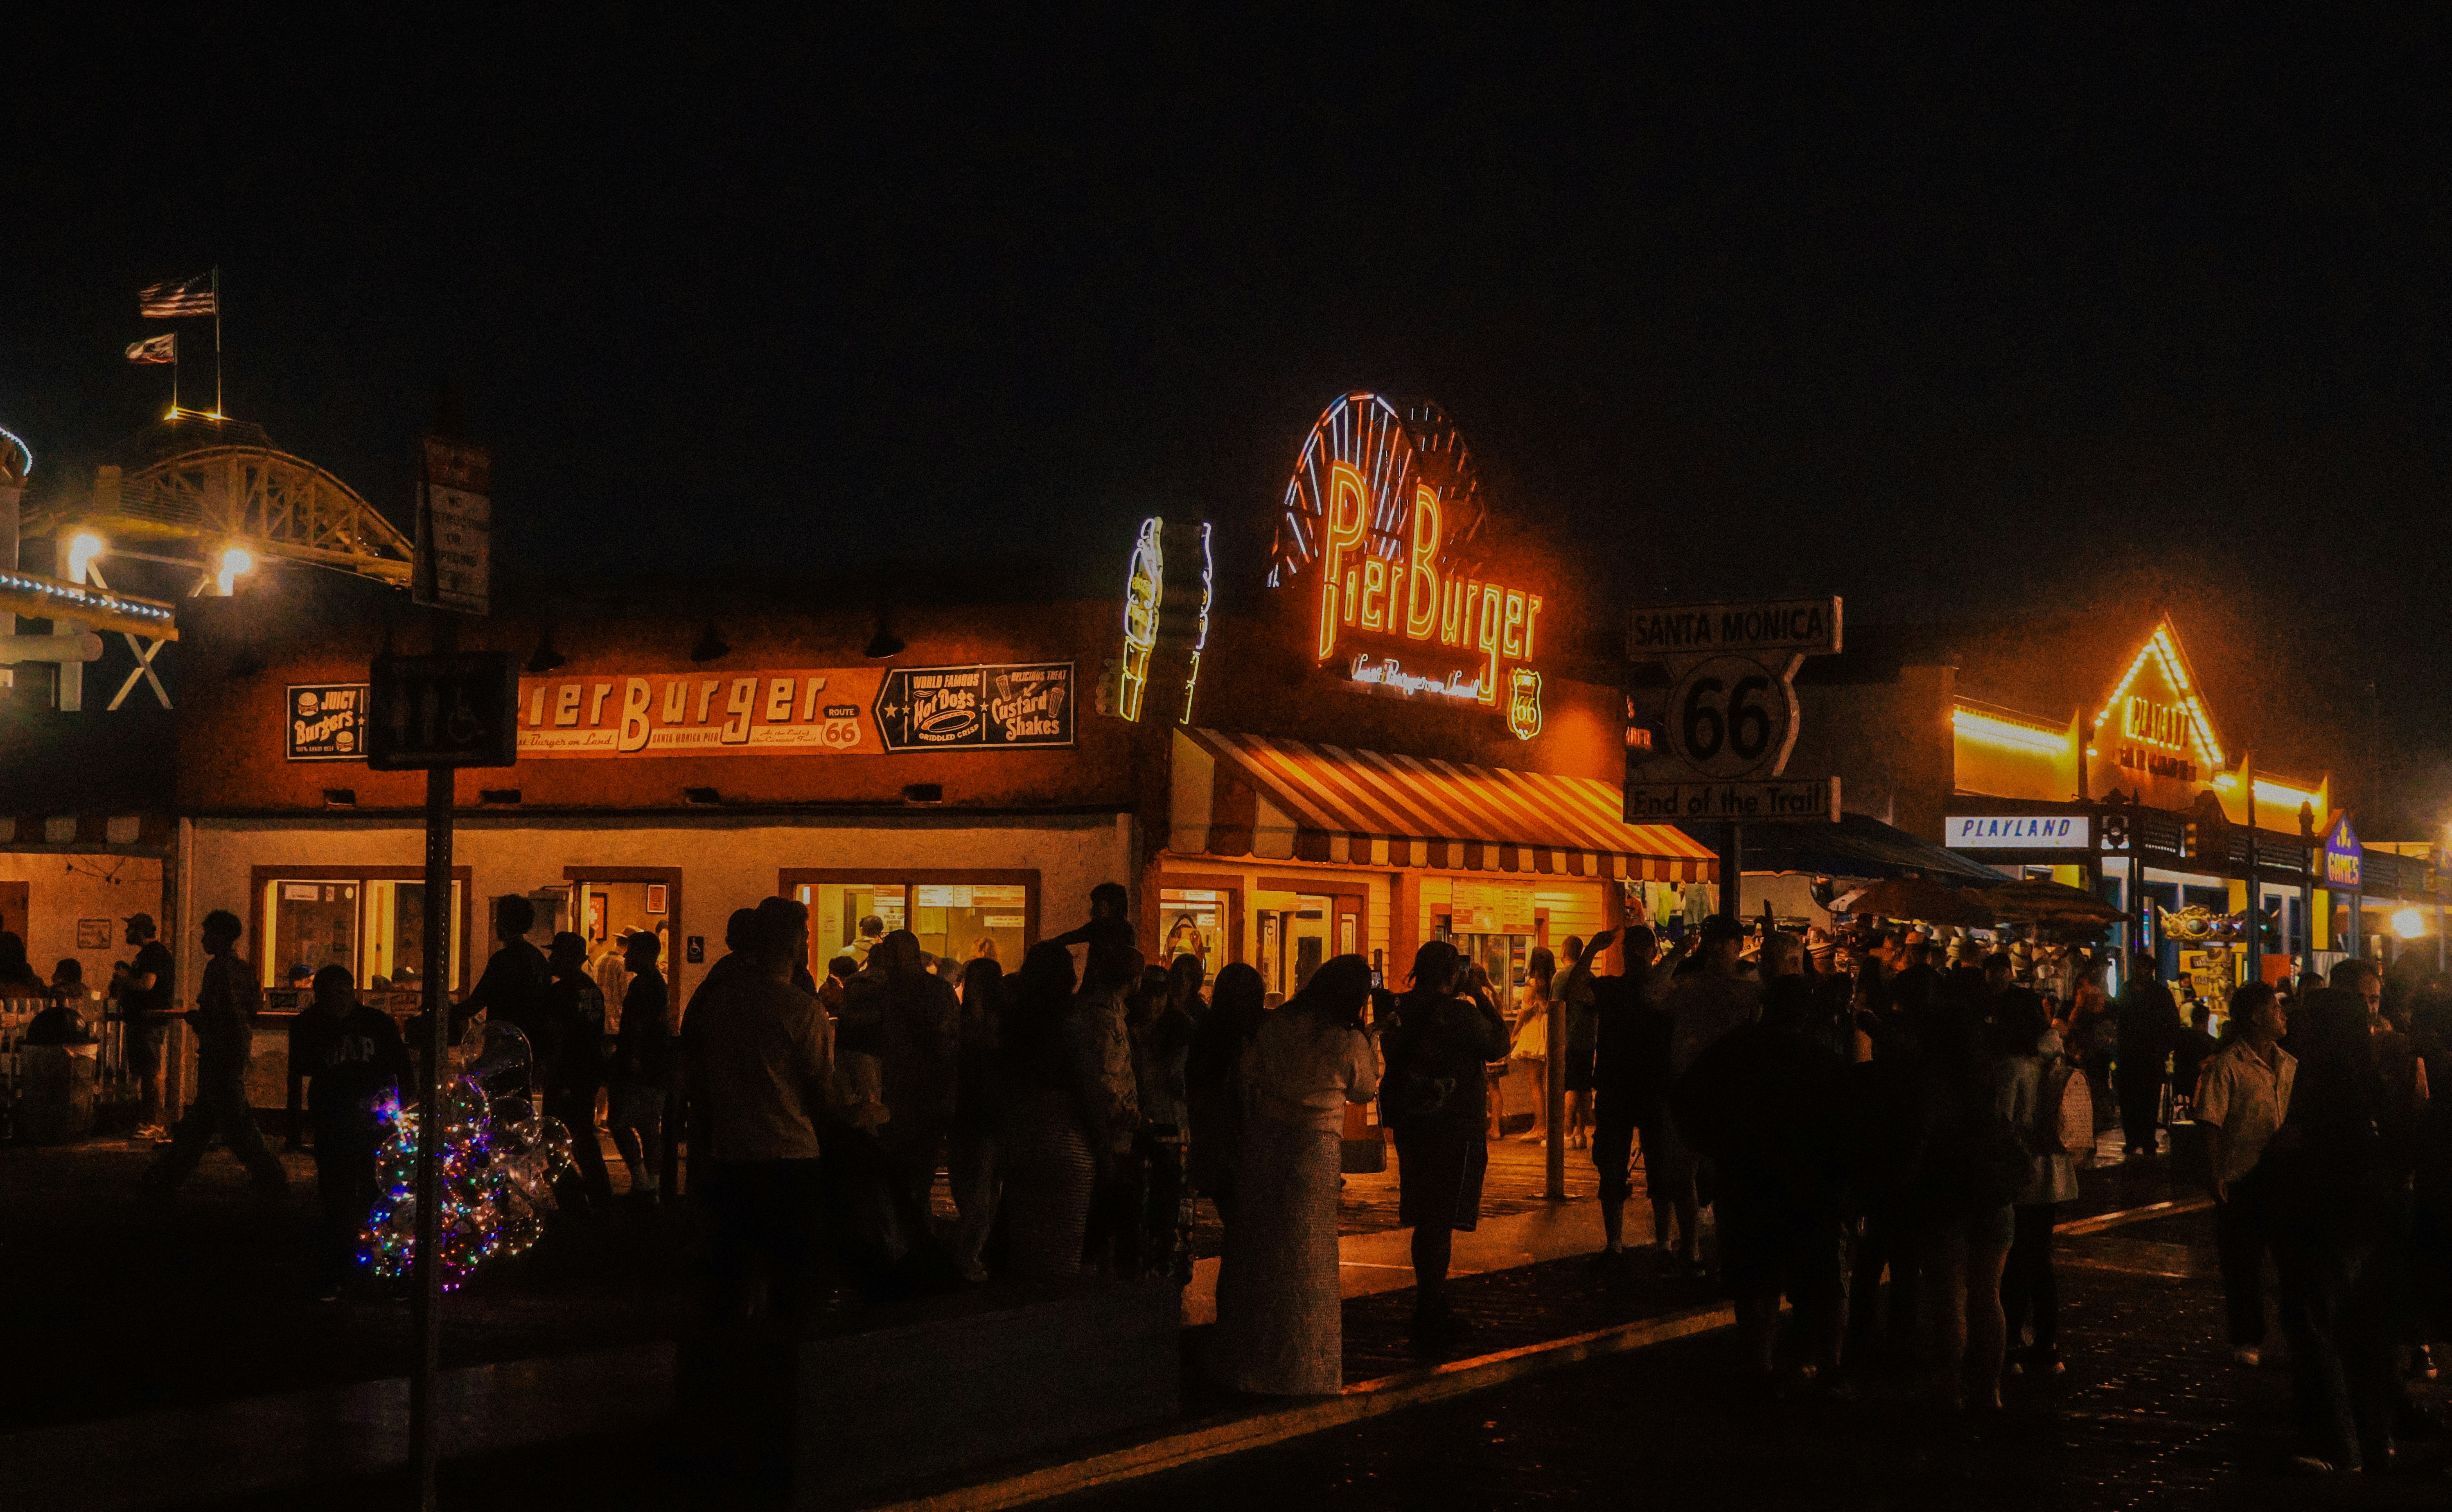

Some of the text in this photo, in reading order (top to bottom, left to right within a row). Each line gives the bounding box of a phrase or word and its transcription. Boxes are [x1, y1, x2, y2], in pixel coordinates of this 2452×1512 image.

[1320, 459, 1543, 706] Pier Burger
[1636, 608, 1824, 644] SANTA MONICA
[913, 673, 979, 689] WORLD FAMOUS
[1011, 670, 1067, 682] DELICIOUS TREAT
[321, 690, 356, 710] JUICY
[914, 688, 975, 731] Hot Dogs
[991, 690, 1047, 725] Custard
[1515, 695, 1537, 723] 66
[294, 710, 354, 745] Burgers
[518, 677, 826, 753] ier Burger
[1005, 715, 1060, 741] Shakes
[1683, 675, 1769, 762] 66
[530, 733, 566, 748] Burger
[582, 732, 613, 745] Land
[826, 722, 855, 743] 66
[918, 724, 979, 741] GRIDDLED CRISP
[1633, 786, 1820, 814] End of the Trail
[1961, 819, 2071, 837] PLAYLAND
[2328, 852, 2360, 885] GAMES
